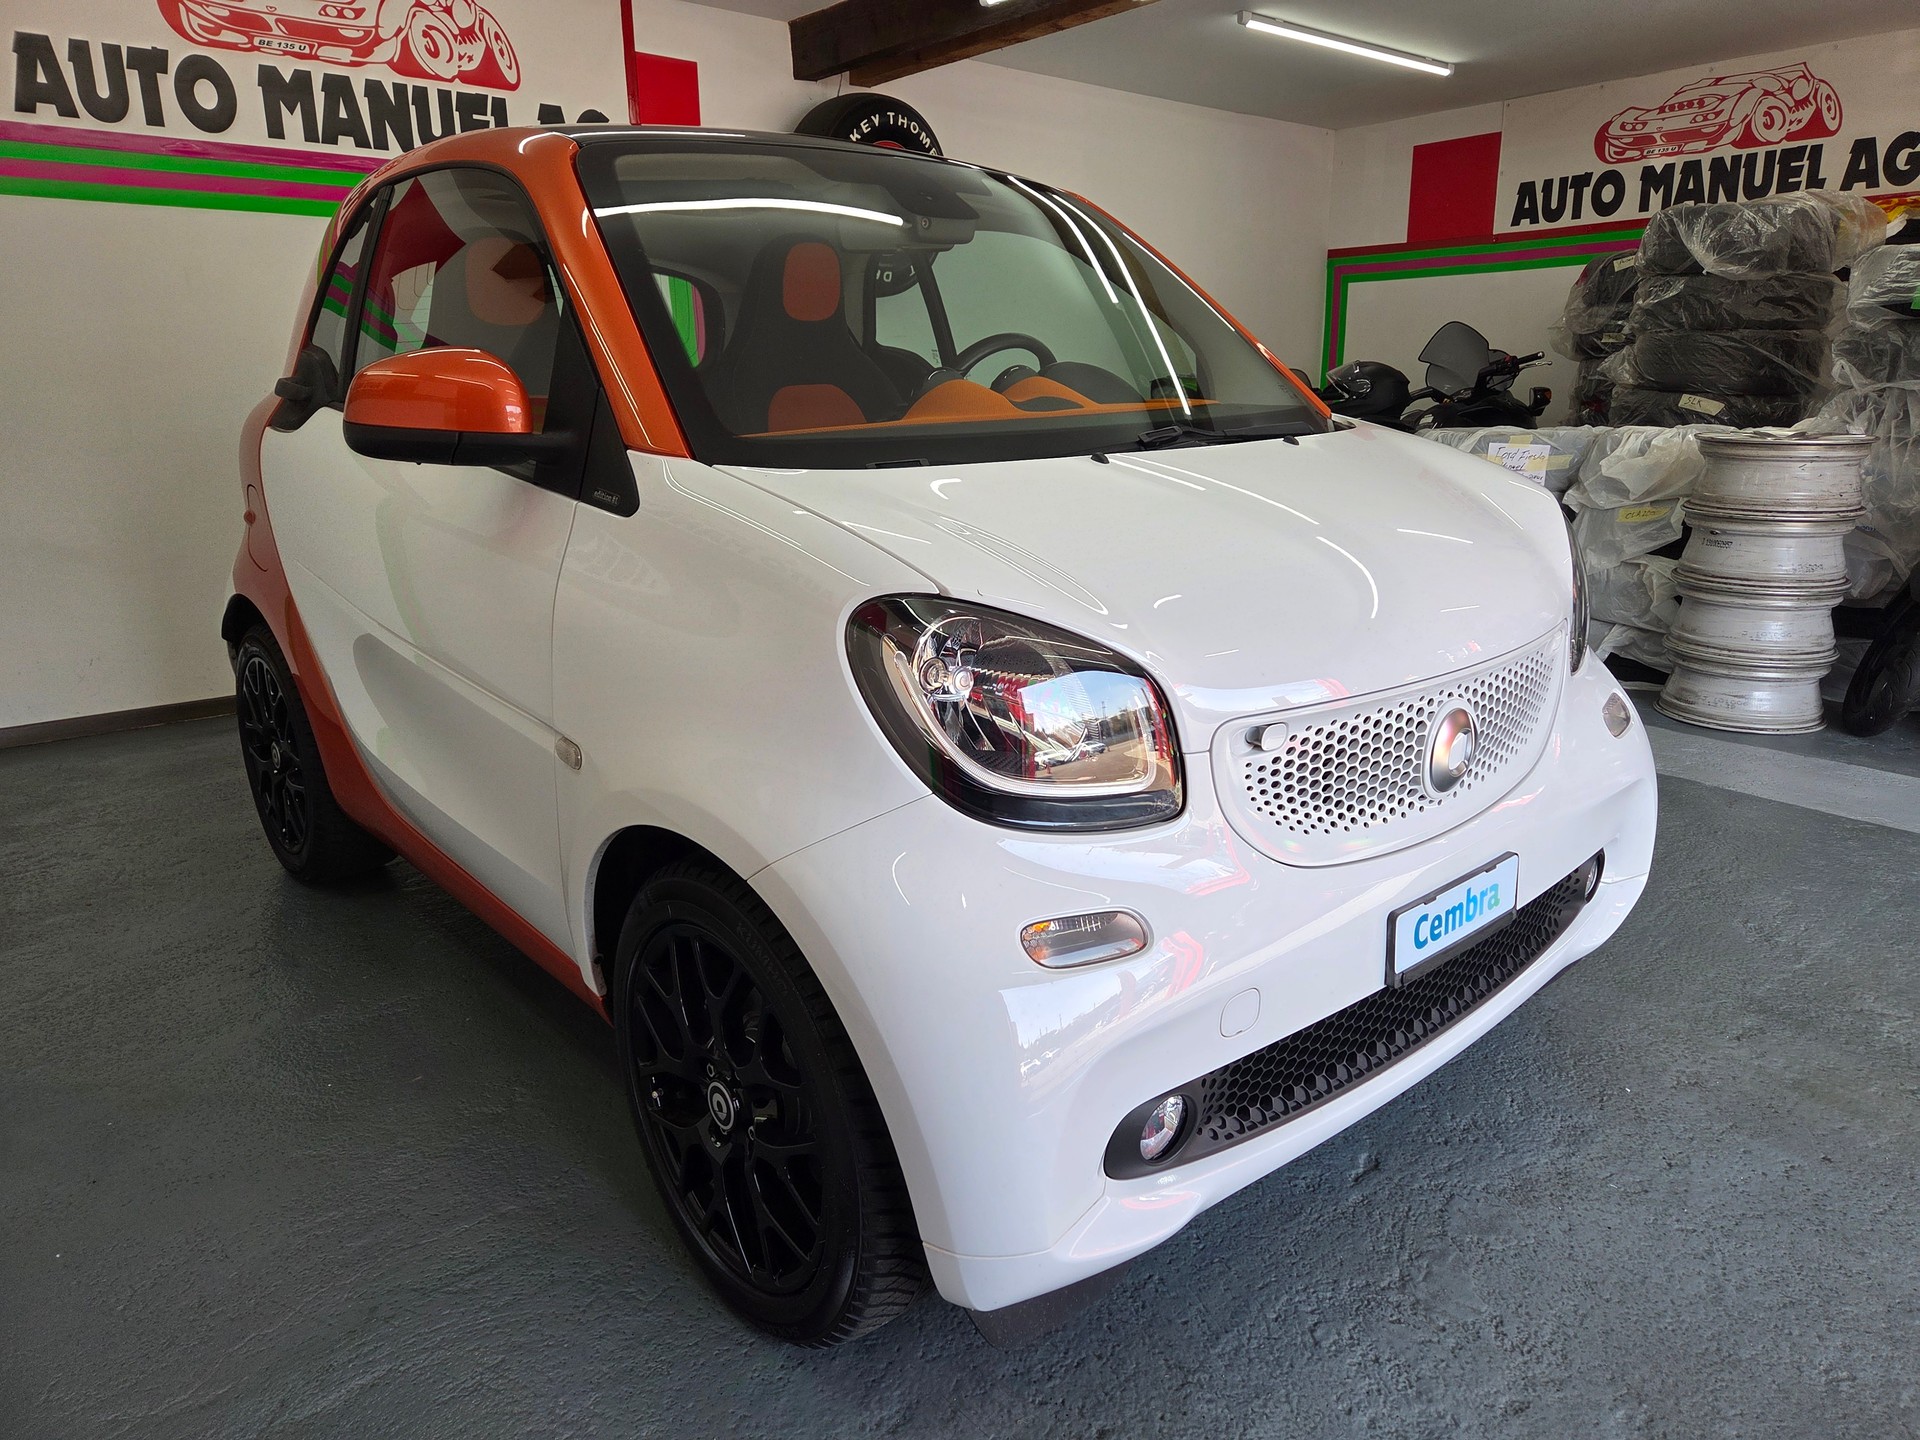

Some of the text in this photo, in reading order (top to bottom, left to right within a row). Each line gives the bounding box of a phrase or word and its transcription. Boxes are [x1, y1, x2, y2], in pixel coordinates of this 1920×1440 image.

[12, 31, 238, 134] AUTO
[277, 42, 296, 50] 135
[1510, 131, 1920, 228] AUTO MANUEL AG
[1413, 883, 1501, 950] Cembra
